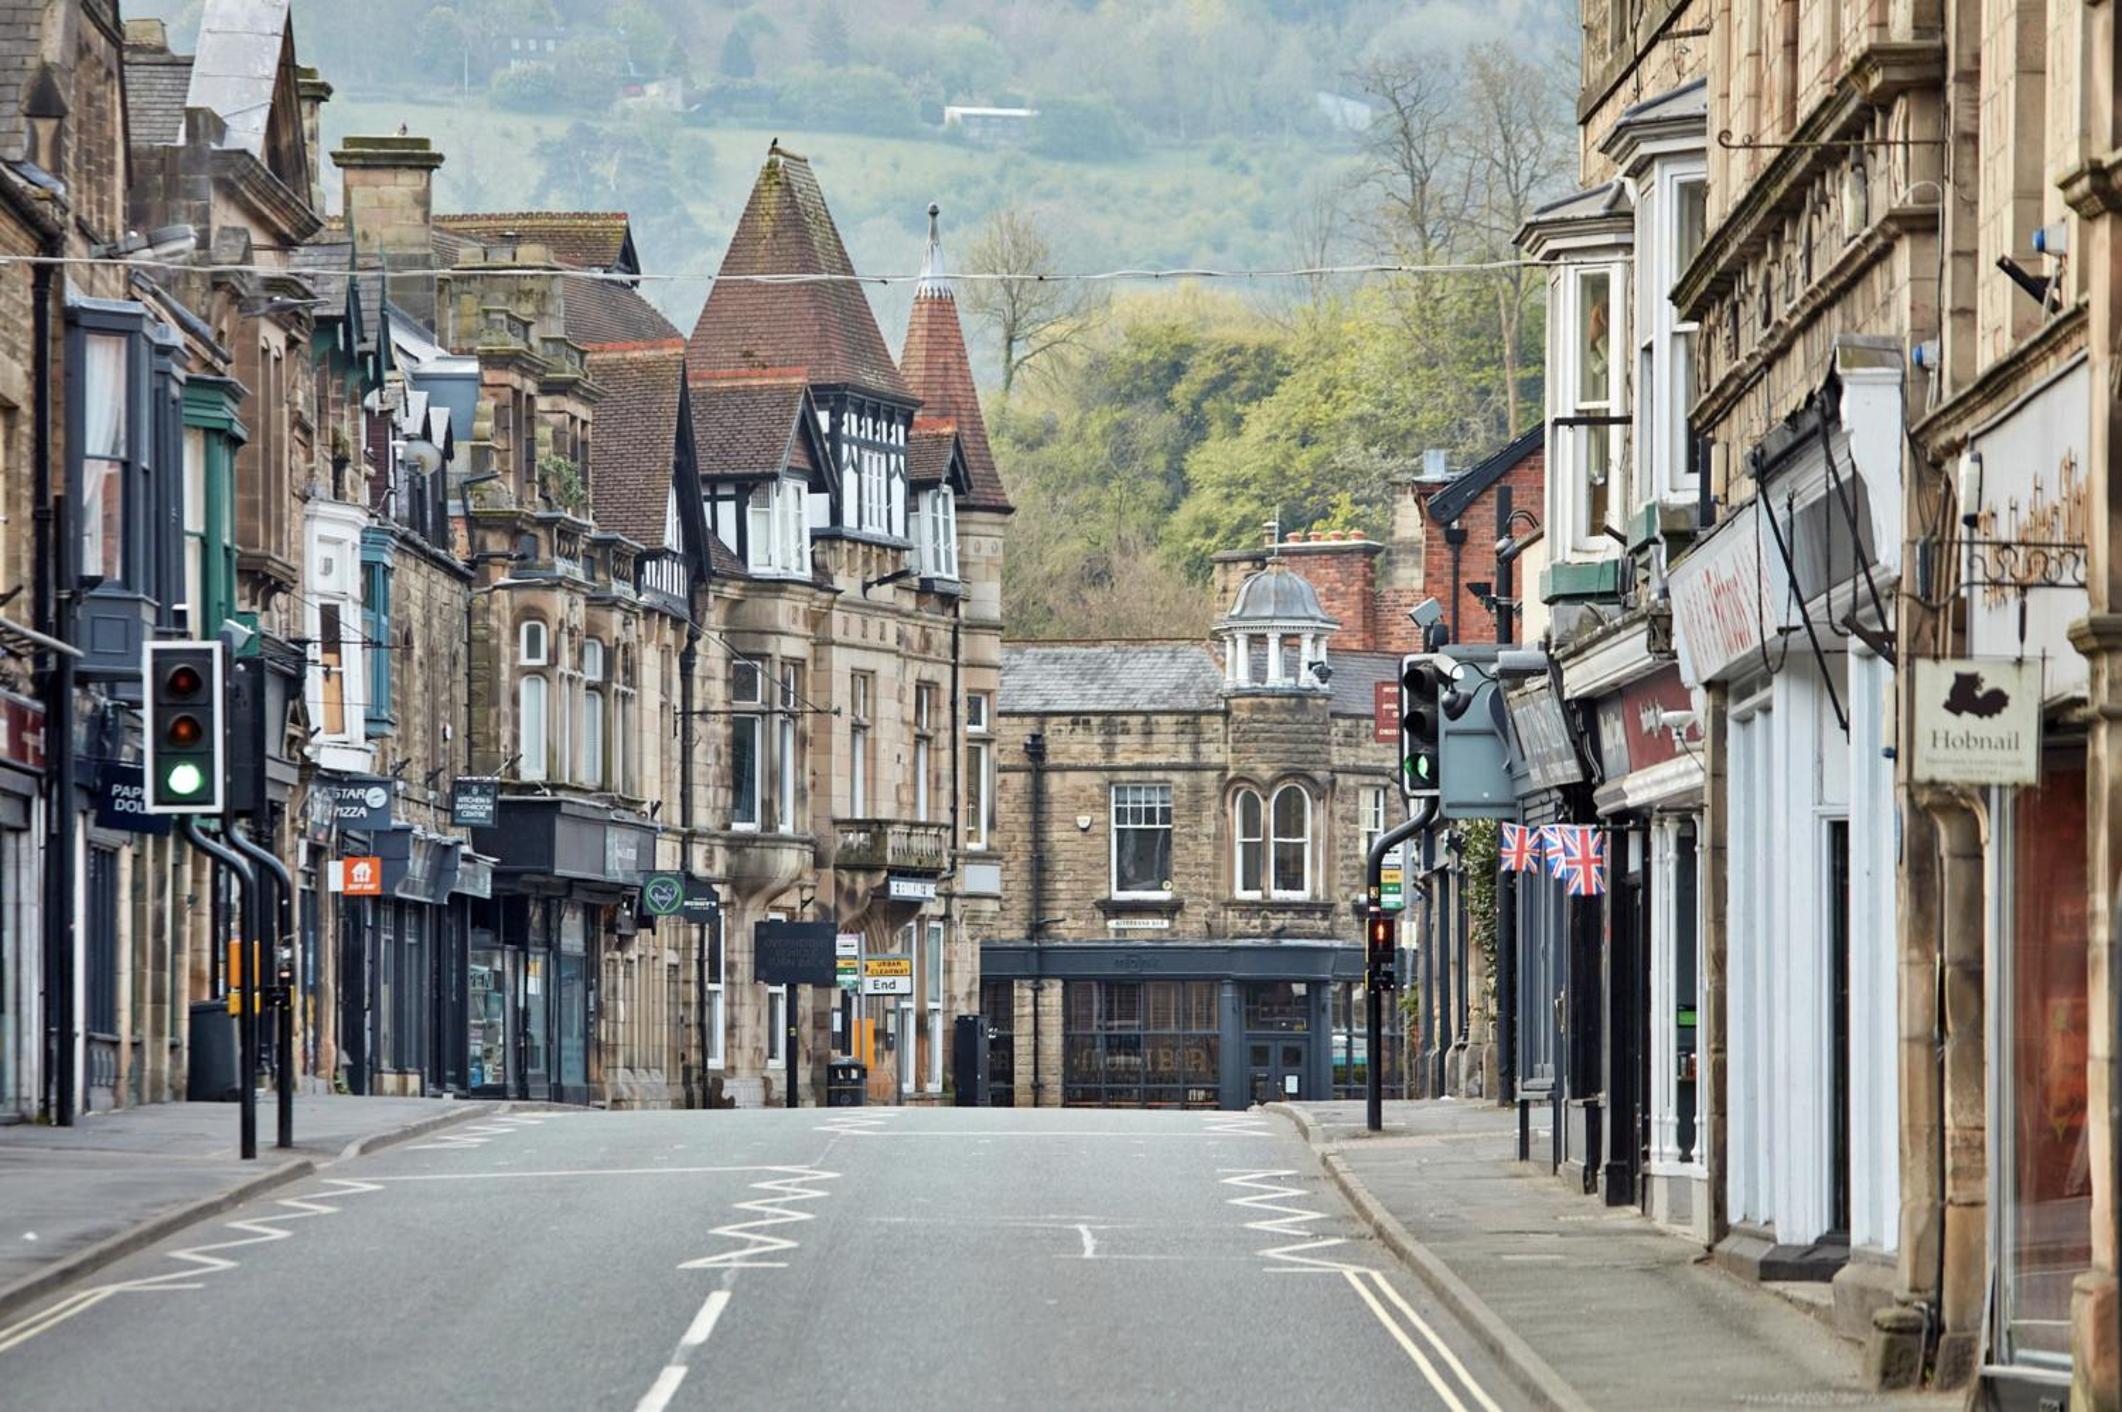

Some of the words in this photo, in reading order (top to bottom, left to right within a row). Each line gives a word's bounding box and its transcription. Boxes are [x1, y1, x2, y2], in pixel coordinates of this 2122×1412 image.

[1931, 728, 2020, 751] Hobnail
[113, 798, 145, 814] DOL
[872, 979, 897, 990] End
